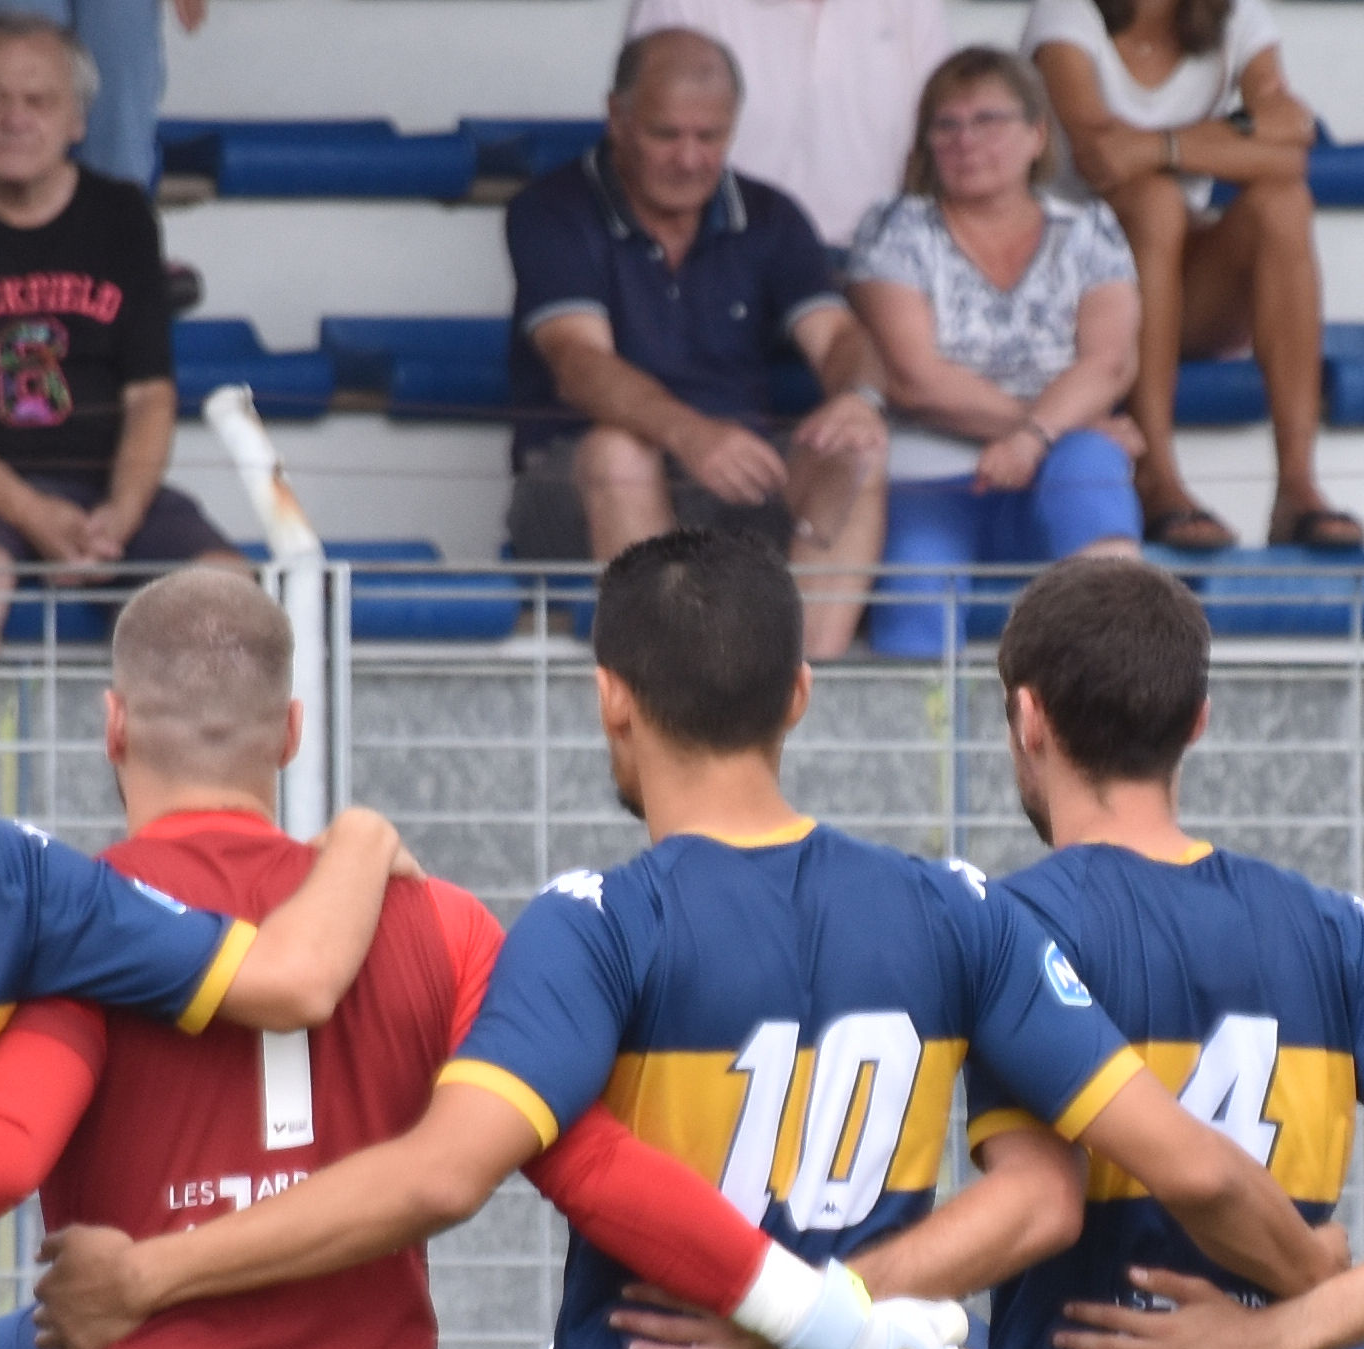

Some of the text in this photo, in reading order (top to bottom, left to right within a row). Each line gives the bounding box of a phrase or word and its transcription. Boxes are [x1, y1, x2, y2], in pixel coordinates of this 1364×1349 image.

[723, 1010, 922, 1232] 10
[1177, 1014, 1279, 1168] 4
[169, 1180, 215, 1211] LES
